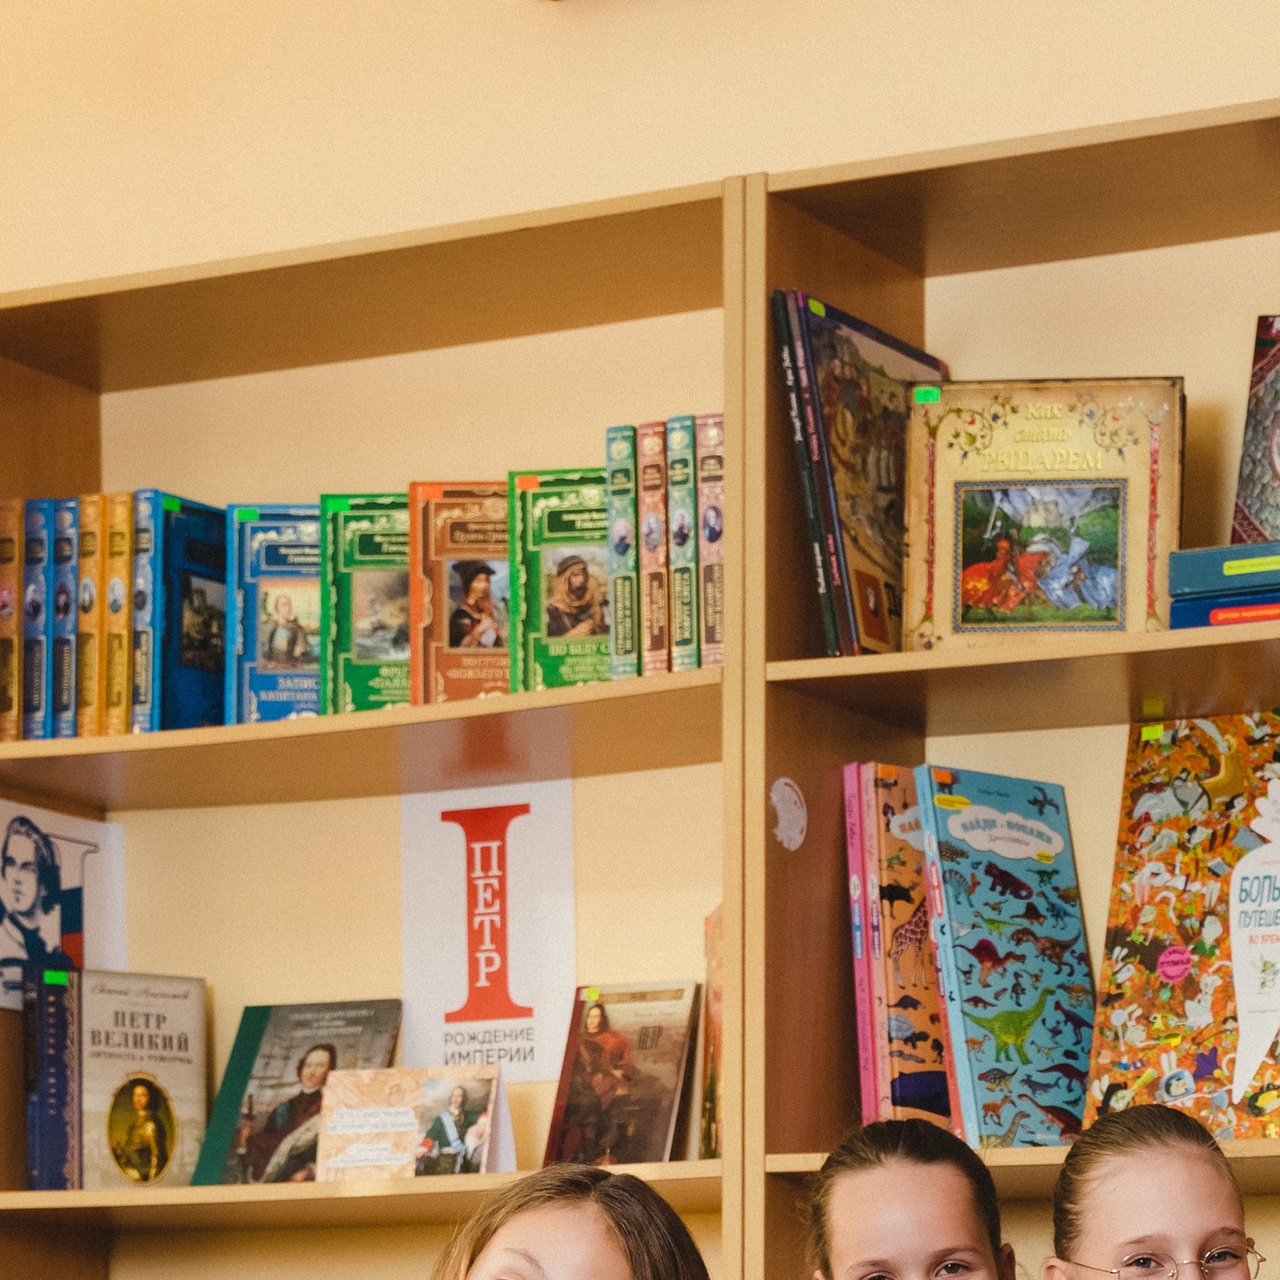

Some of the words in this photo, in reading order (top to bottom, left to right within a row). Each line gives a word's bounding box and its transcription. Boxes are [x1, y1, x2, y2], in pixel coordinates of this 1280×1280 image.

[470, 841, 503, 988] ПЕТР
[113, 1010, 168, 1031] ПЕТР
[90, 1031, 190, 1054] ВЕЛИКИЙ
[444, 1027, 535, 1045] РОЖДЕНИЕ
[444, 1046, 535, 1066] ИМПЕРИИ
